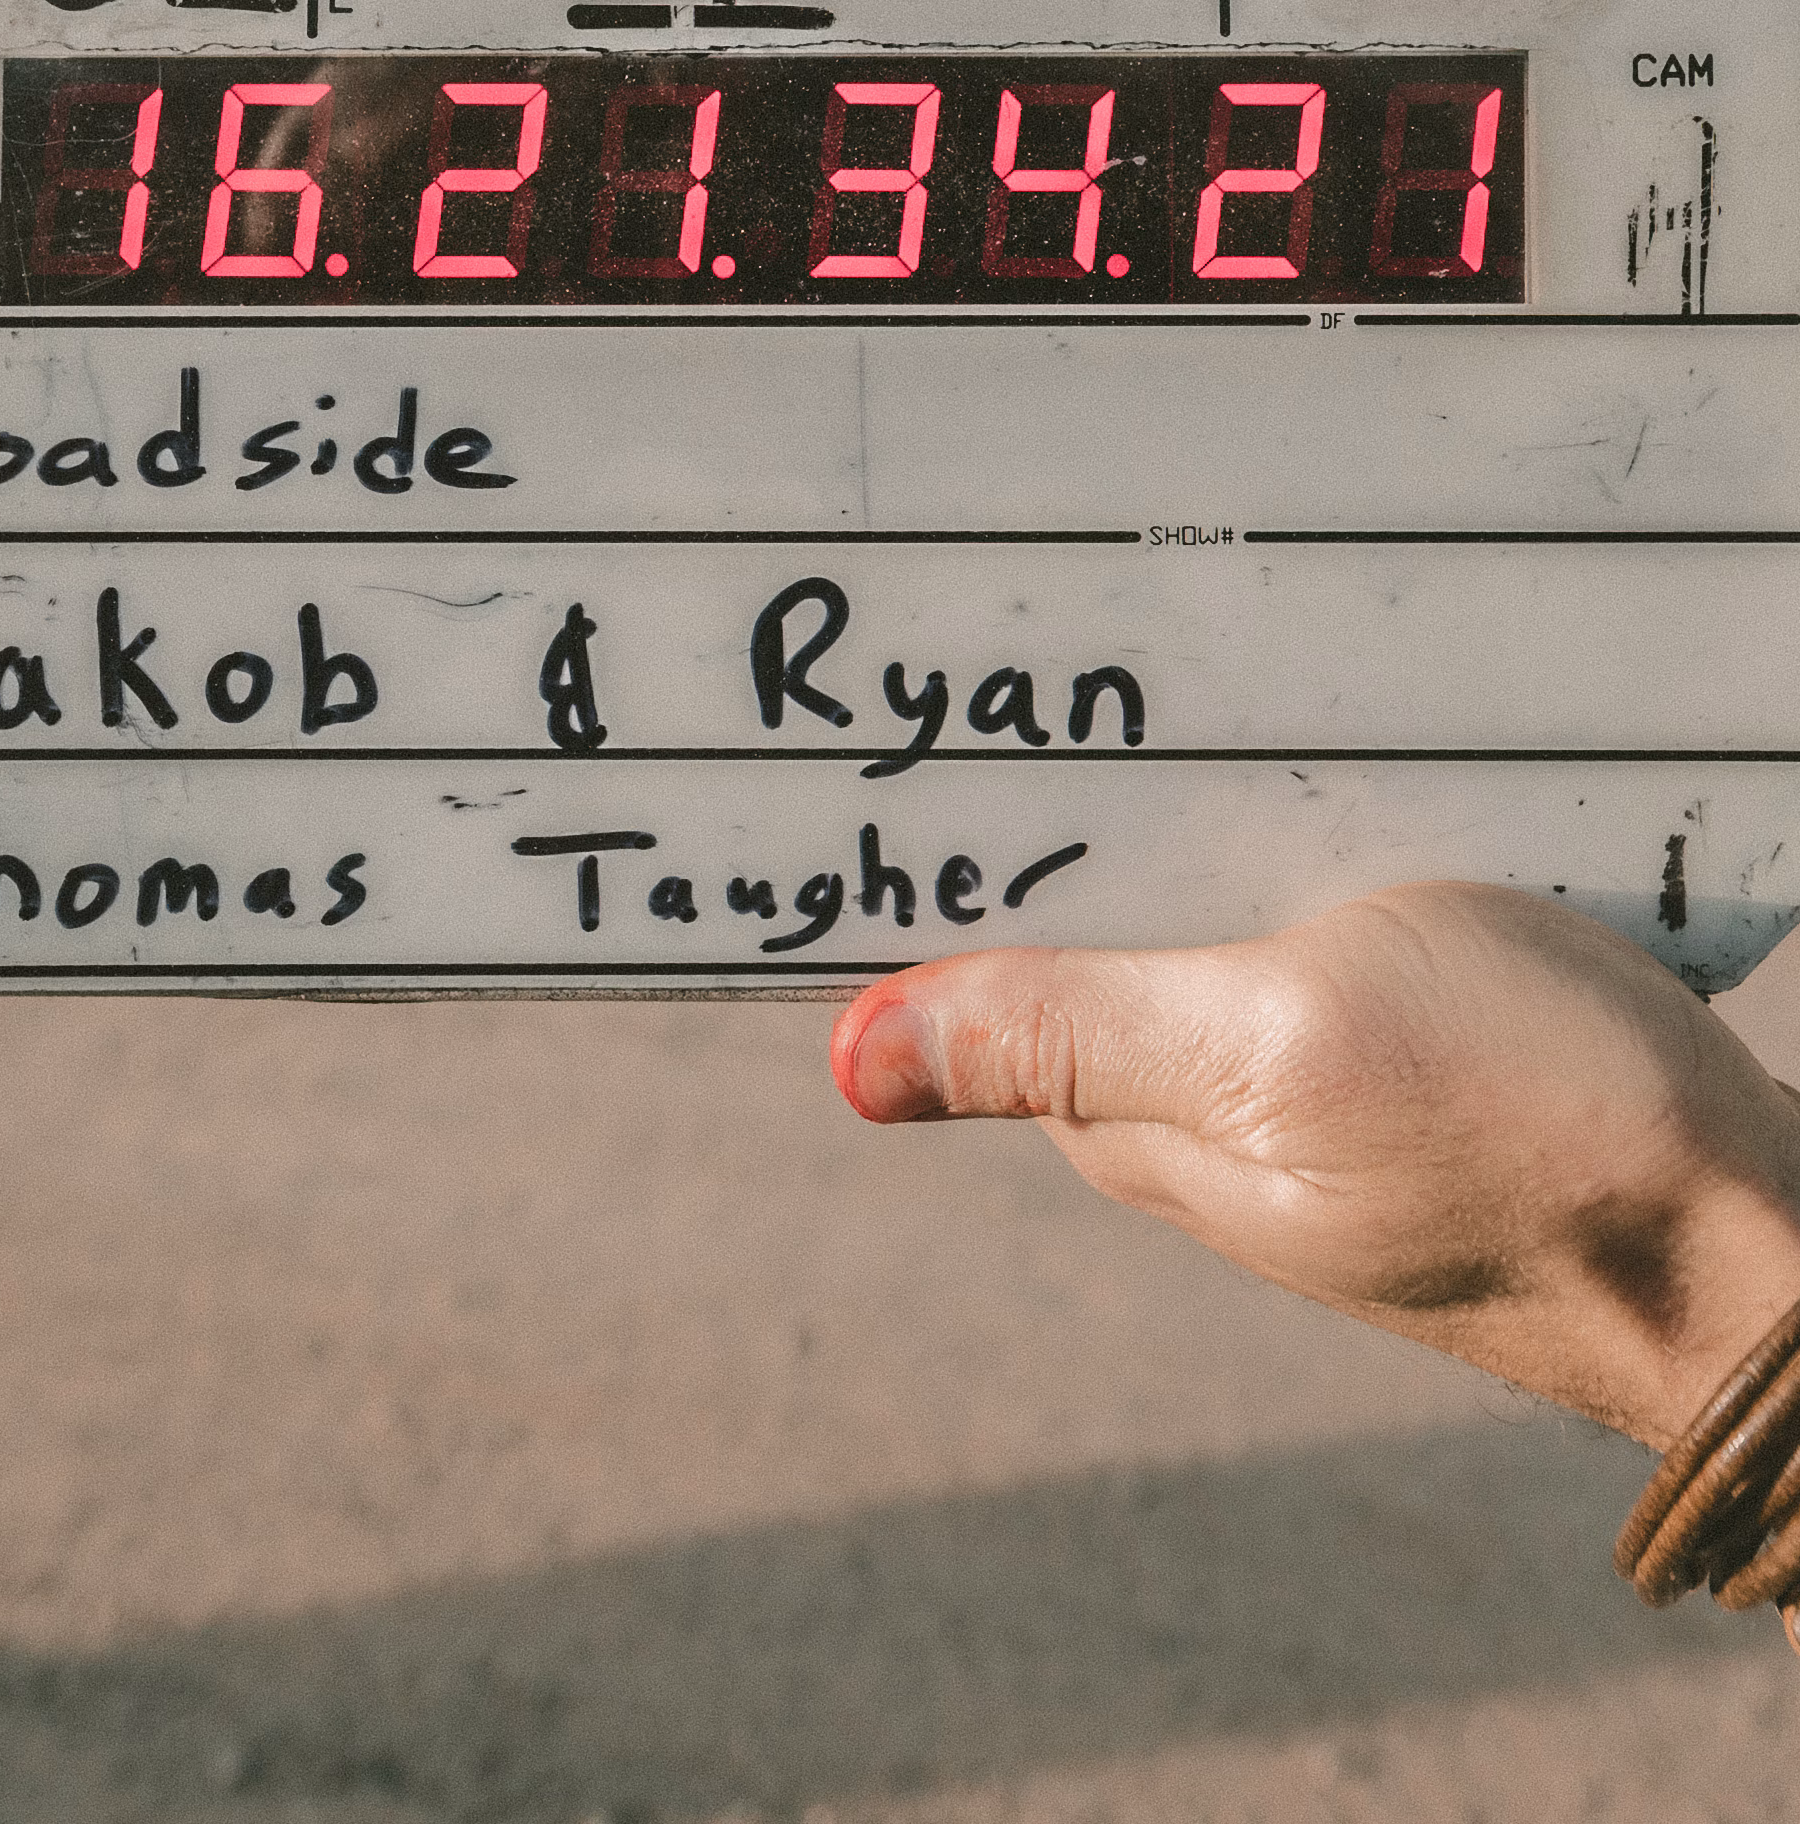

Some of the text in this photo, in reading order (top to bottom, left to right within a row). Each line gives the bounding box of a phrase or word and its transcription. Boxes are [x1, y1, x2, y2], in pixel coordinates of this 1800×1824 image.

[1631, 53, 1715, 88] CAM
[1319, 311, 1346, 331] DF
[1148, 525, 1235, 547] SHOW#
[750, 576, 1145, 779] Ryan
[510, 822, 1088, 955] Taugher
